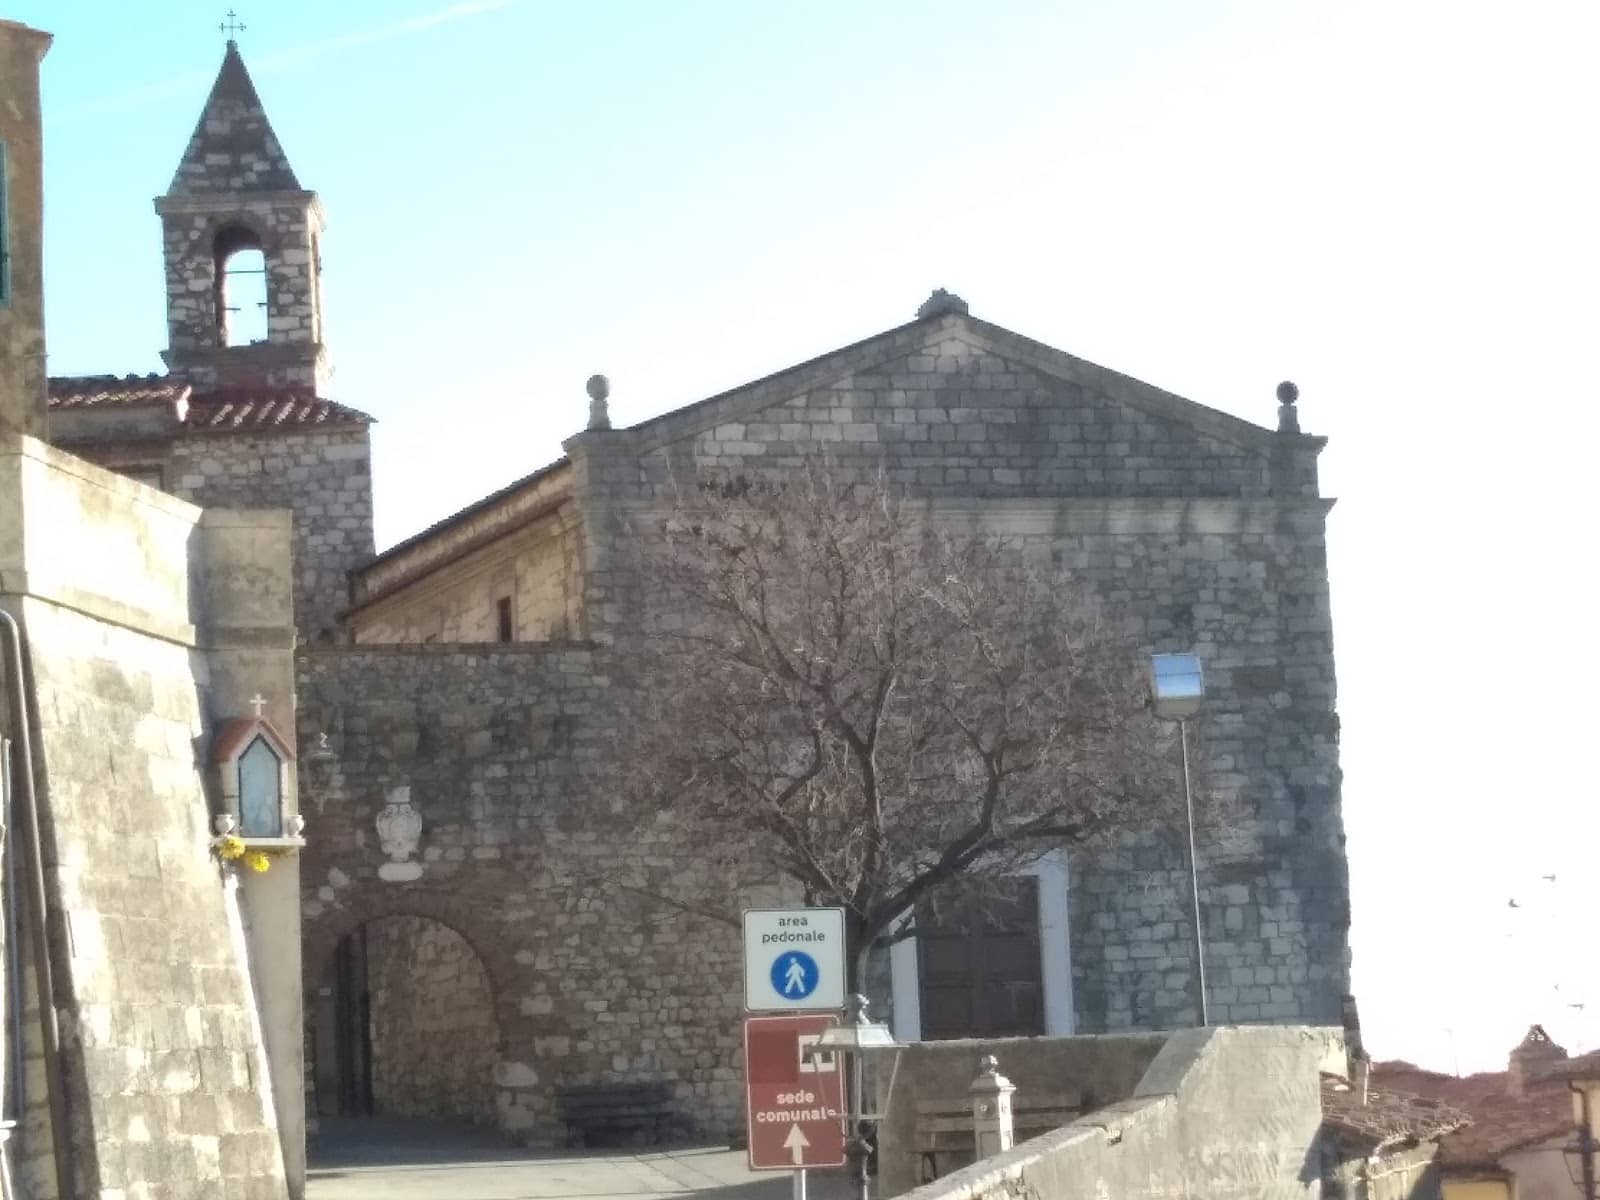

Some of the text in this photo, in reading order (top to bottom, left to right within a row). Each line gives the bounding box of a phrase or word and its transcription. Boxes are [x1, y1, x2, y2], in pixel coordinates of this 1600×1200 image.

[779, 917, 808, 926] area
[762, 931, 825, 944] pedonale
[776, 1090, 815, 1104] sede
